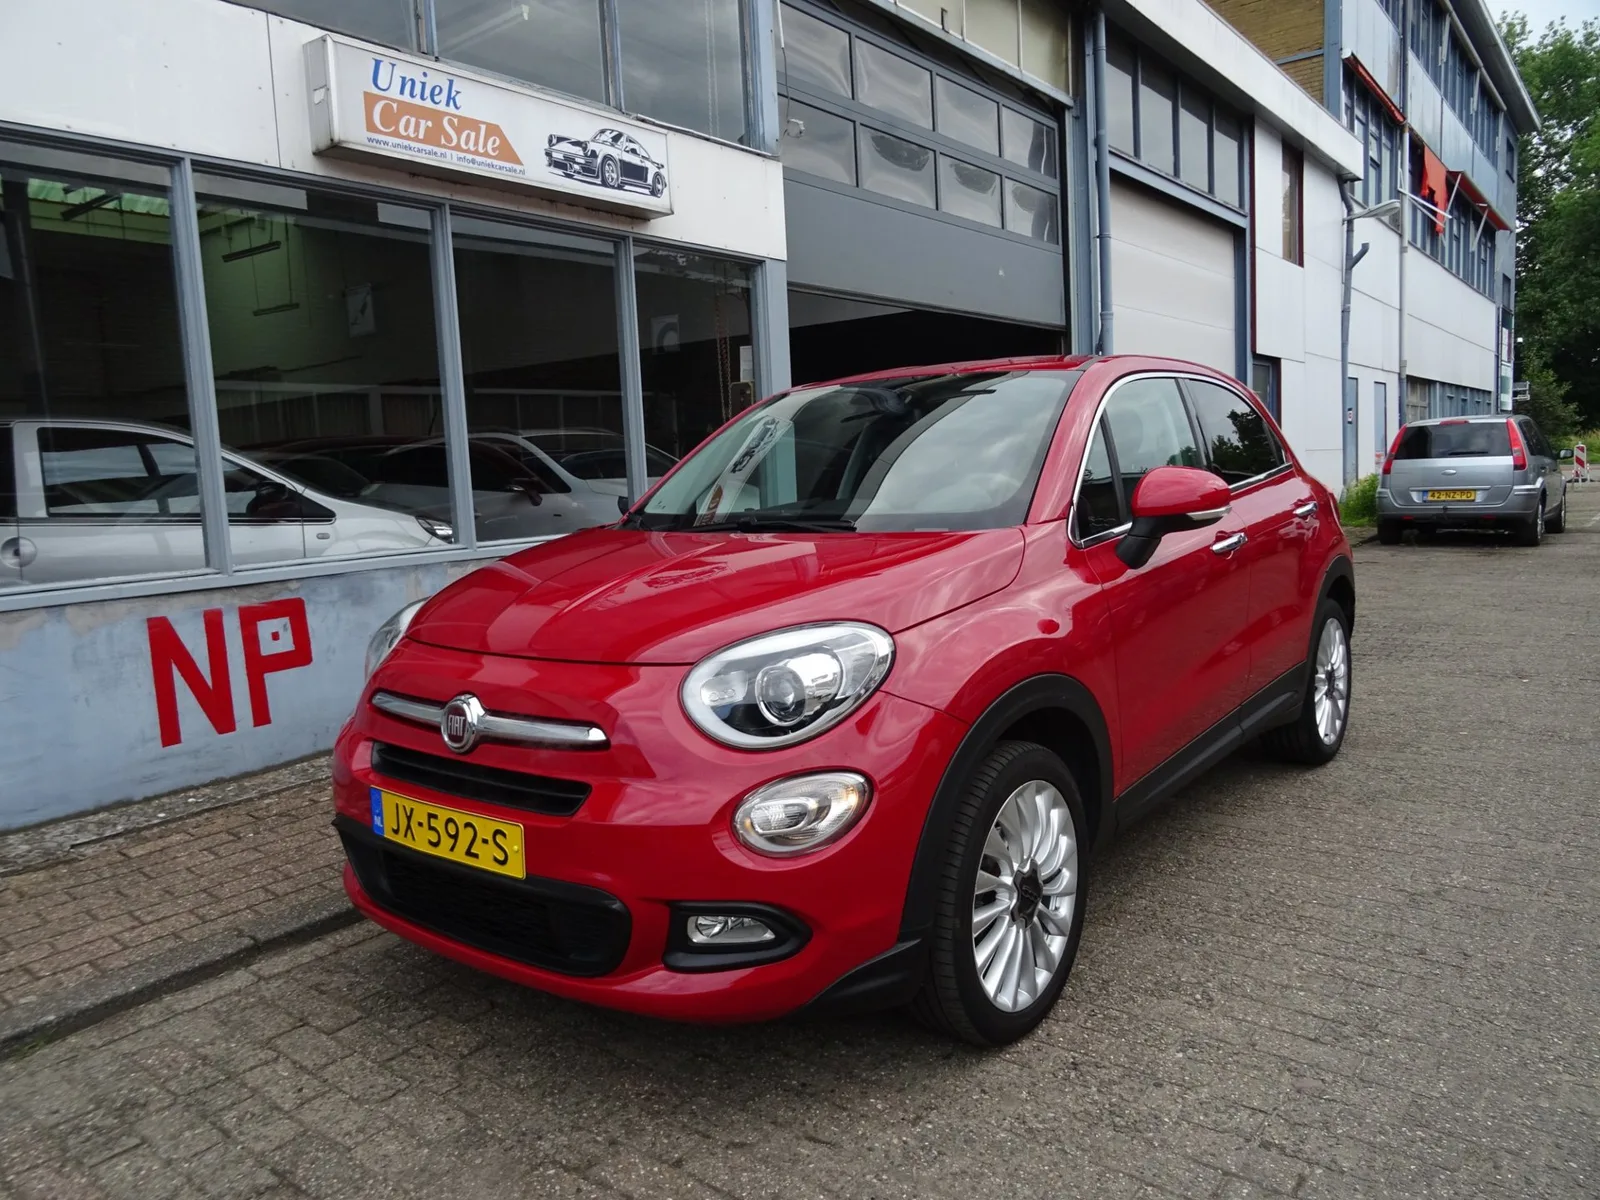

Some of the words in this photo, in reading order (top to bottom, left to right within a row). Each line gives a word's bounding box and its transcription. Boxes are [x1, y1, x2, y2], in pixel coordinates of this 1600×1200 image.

[372, 58, 461, 110] Uniek
[373, 100, 432, 140] Car
[441, 115, 500, 156] Sale
[366, 136, 447, 159] www.uniekcarsale.nl
[456, 155, 526, 176] info@uniekcarsale.nl
[1430, 491, 1473, 499] 42-NZ-PD
[146, 597, 313, 748] NP
[447, 714, 465, 737] FIAT
[391, 801, 509, 866] JX-592-S
